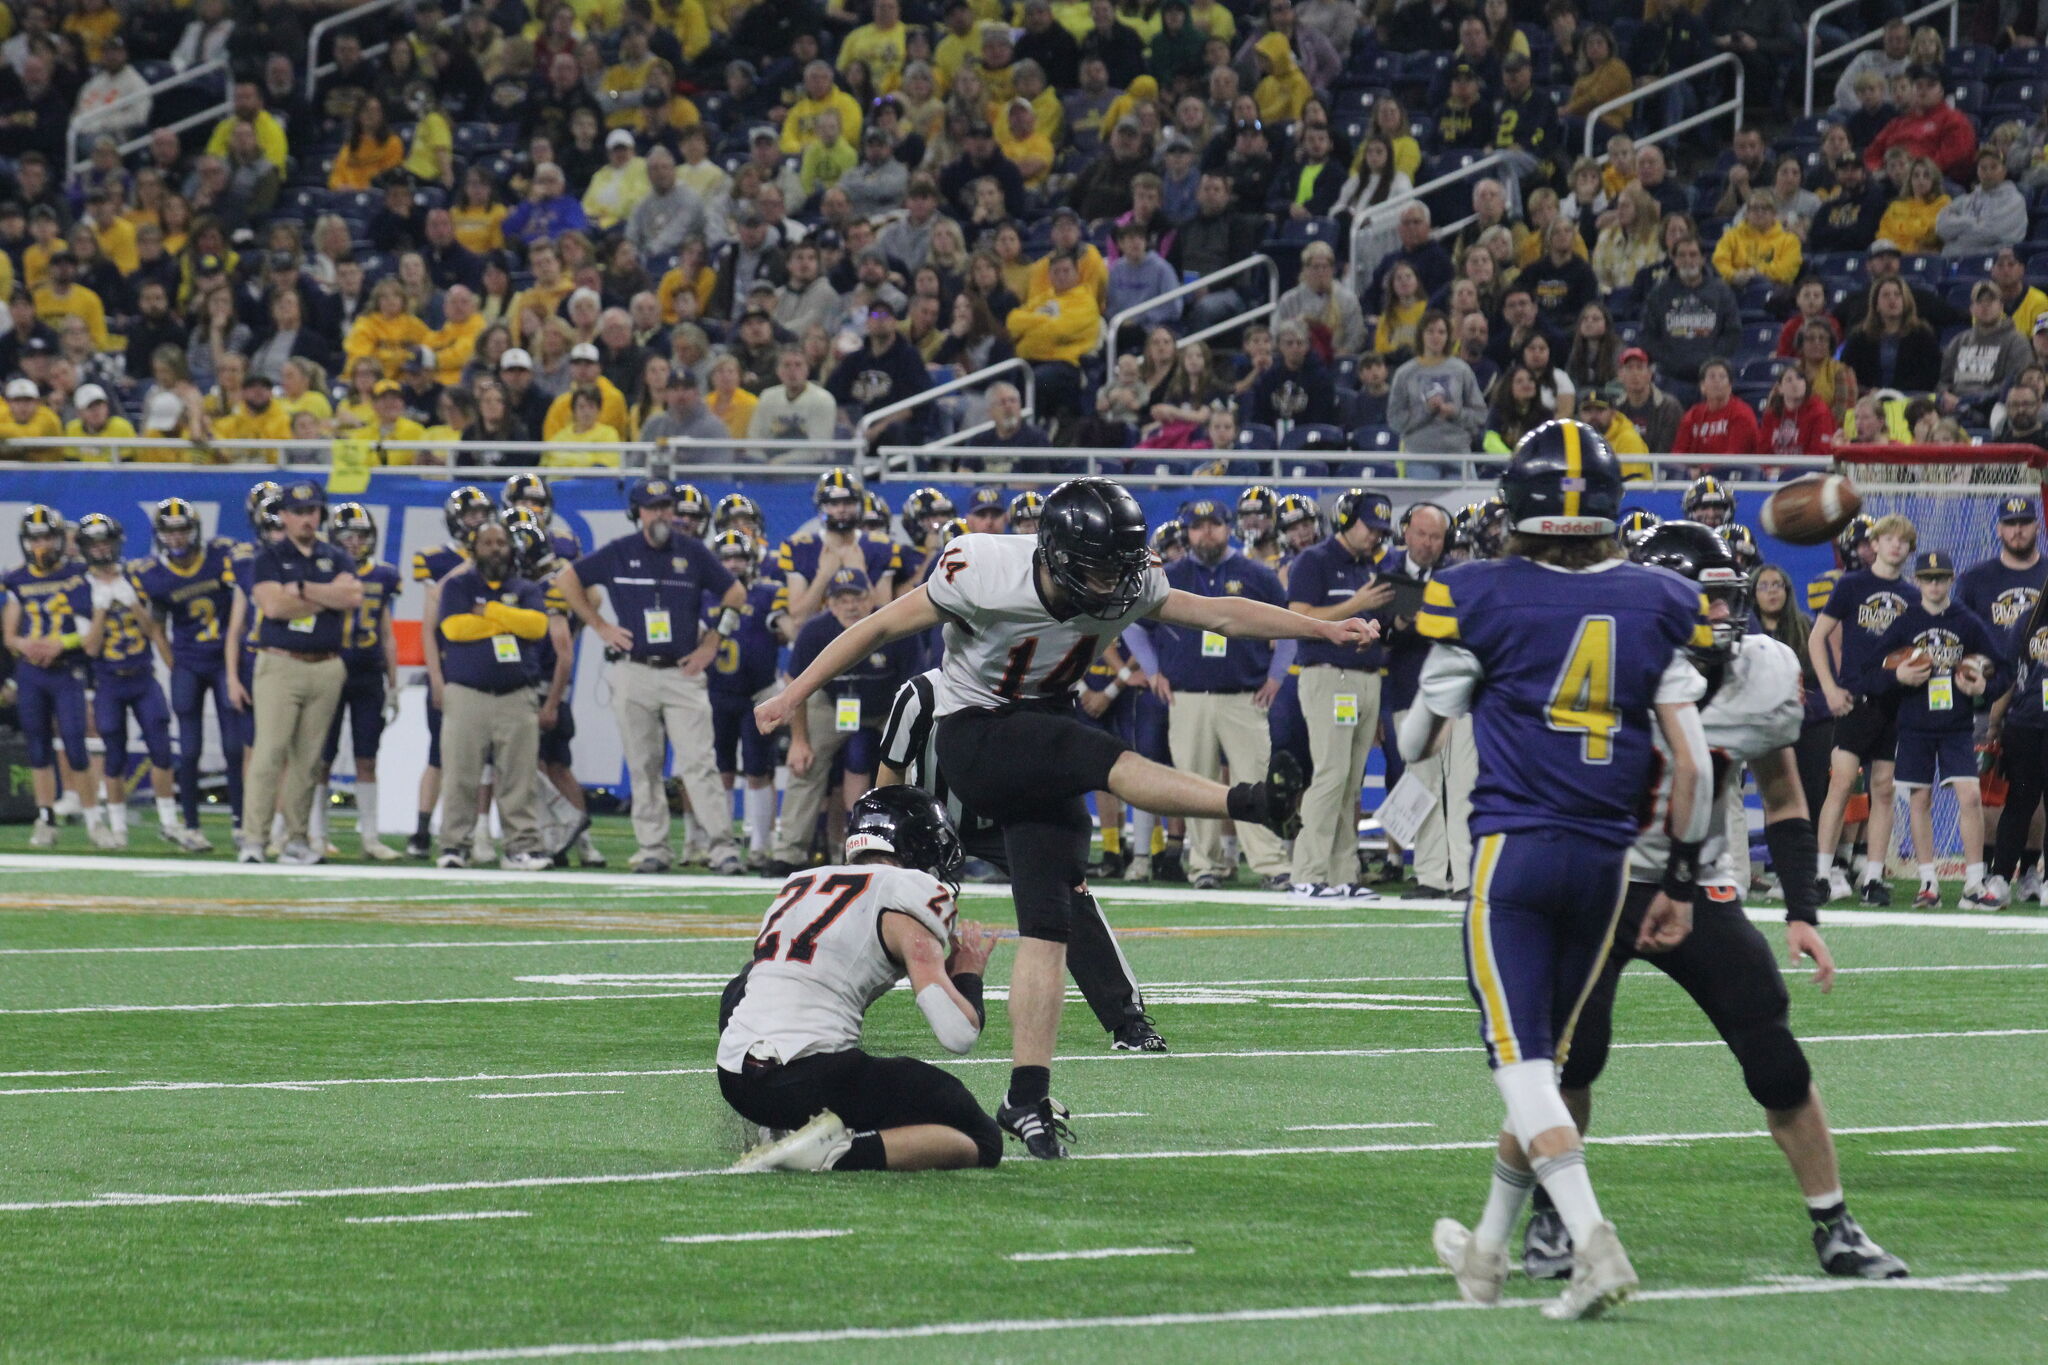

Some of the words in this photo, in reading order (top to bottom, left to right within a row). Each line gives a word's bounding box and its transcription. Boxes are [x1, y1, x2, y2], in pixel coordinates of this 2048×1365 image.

[1541, 520, 1602, 534] Riddell
[939, 547, 968, 584] 14
[992, 634, 1101, 700] 14
[1544, 614, 1622, 765] 4
[753, 872, 874, 966] 27
